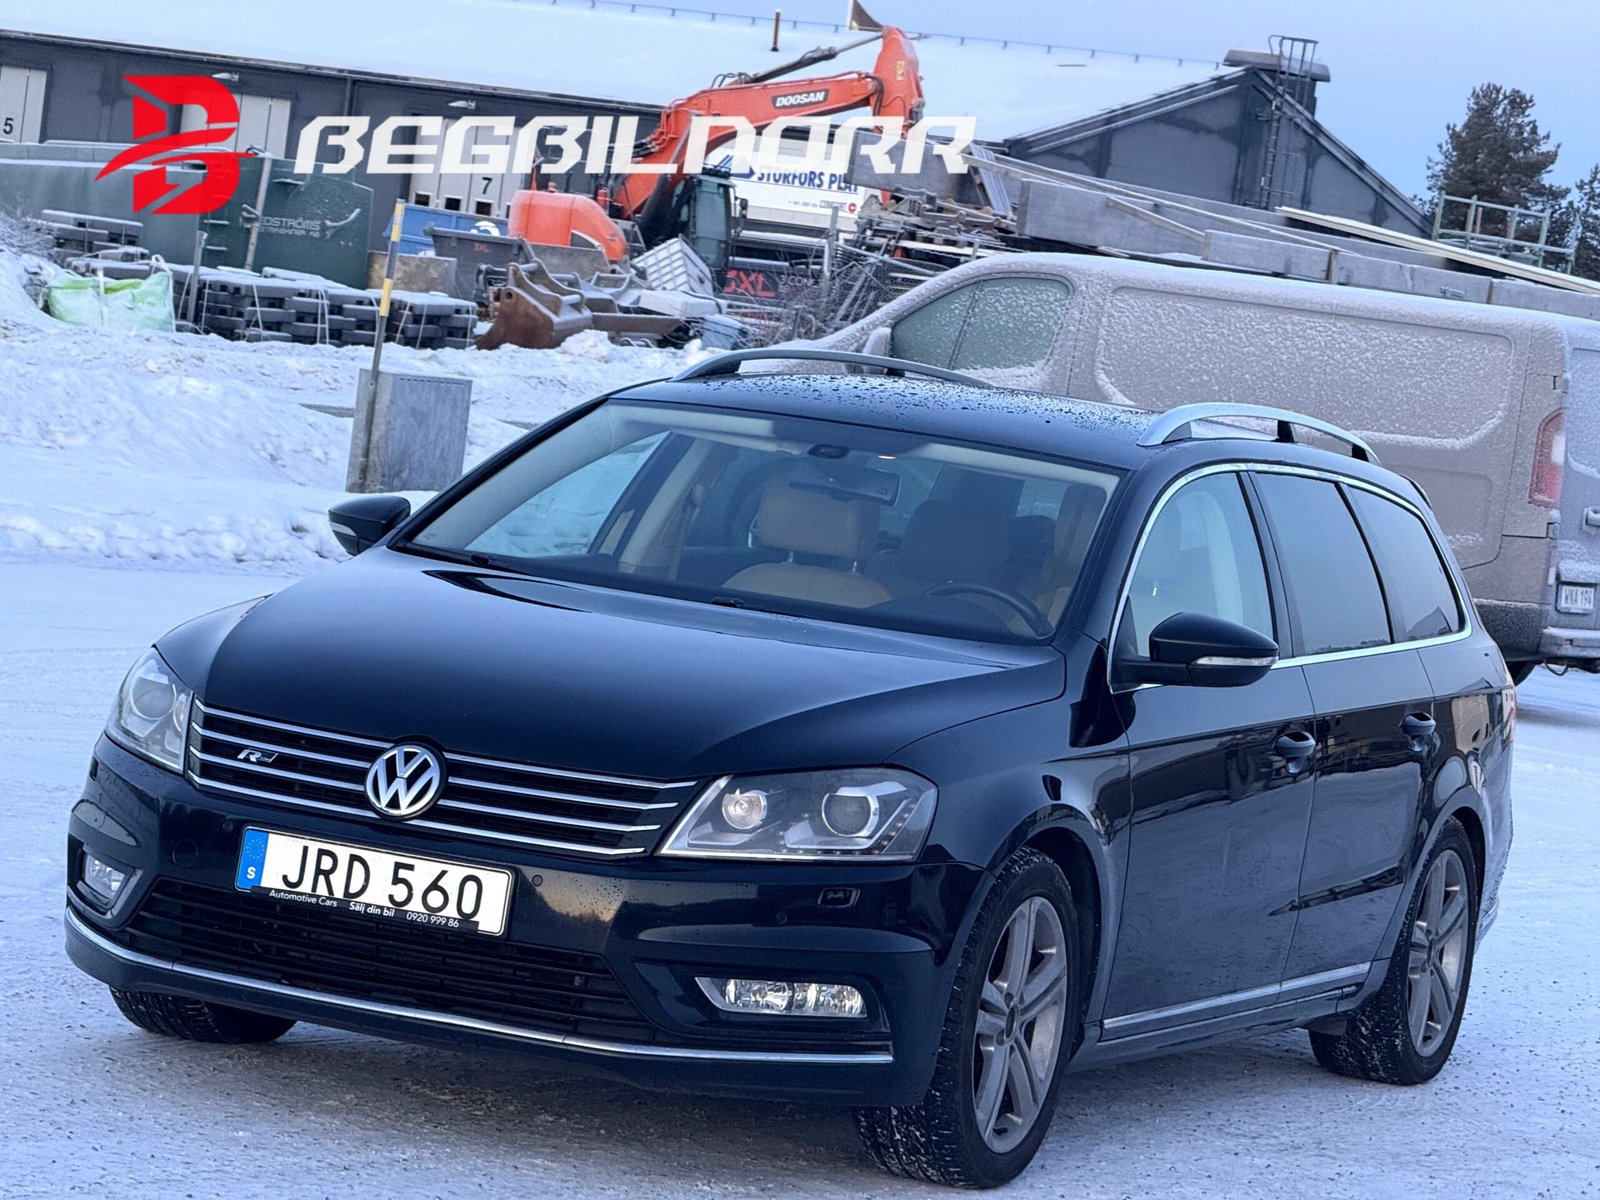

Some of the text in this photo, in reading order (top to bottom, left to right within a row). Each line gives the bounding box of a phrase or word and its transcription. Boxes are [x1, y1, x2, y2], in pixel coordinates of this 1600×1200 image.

[775, 91, 826, 107] DOOSAN
[3, 116, 14, 135] 5
[482, 176, 493, 195] 7
[259, 217, 321, 231] EDSTRÖMS
[246, 866, 256, 880] S
[281, 845, 483, 920] JRD 560
[269, 889, 459, 928] Automotive Cars Sälj din bil 0920 999 86
